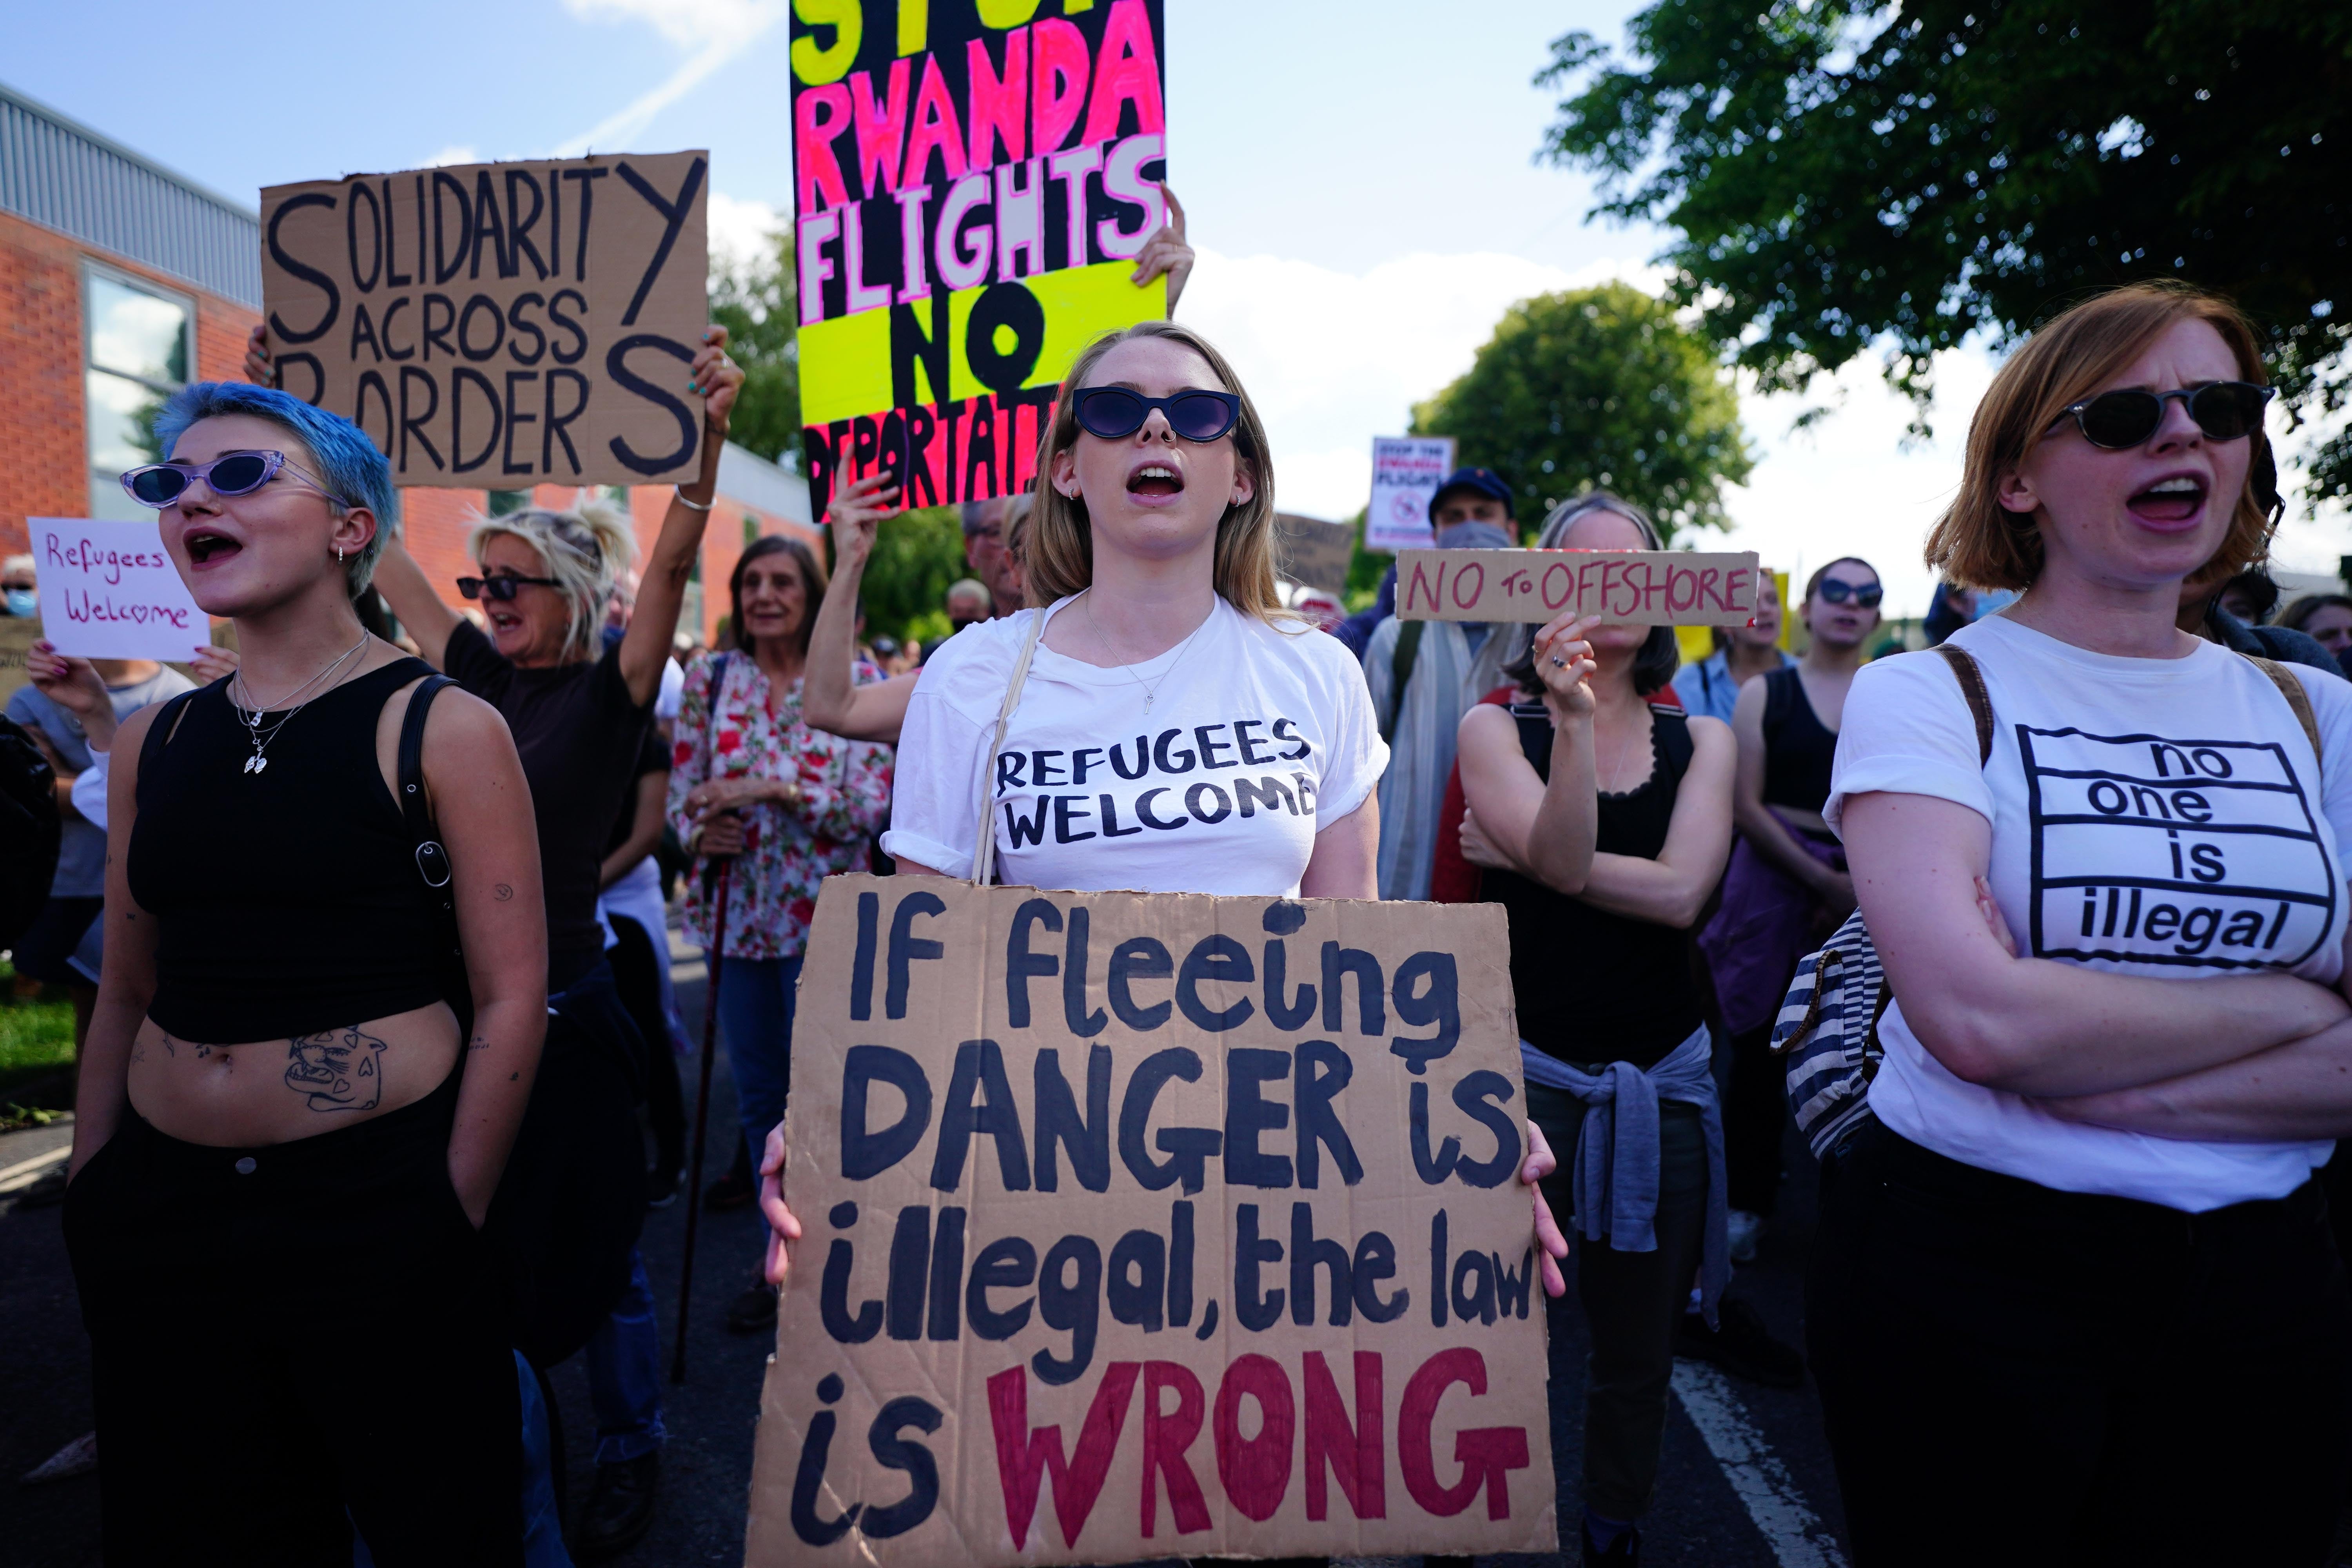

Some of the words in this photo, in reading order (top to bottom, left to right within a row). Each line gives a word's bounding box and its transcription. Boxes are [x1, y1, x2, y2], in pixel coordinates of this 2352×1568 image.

[796, 1, 1165, 214] RWANDA
[268, 156, 707, 344] SOLIDARITY
[798, 134, 1166, 327] FLIGHTS
[350, 289, 588, 365] ACROSS
[890, 281, 1045, 410] NO
[46, 532, 165, 585] Refugees
[1406, 560, 1485, 613] NO
[1541, 559, 1749, 619] OFFSHORE
[997, 718, 1312, 798] REFUGEES
[2150, 743, 2233, 779] no
[1005, 772, 1315, 849] WELCOME
[2087, 780, 2214, 824] one
[2167, 828, 2226, 883] is
[2080, 886, 2290, 955] illegal
[1006, 899, 1460, 1061] fleeing
[840, 1038, 1364, 1196] DANGER
[1405, 1056, 1521, 1189] is
[1234, 1201, 1410, 1331] the
[1430, 1208, 1533, 1328] law
[790, 1373, 944, 1548] is
[986, 1347, 1530, 1553] WRONG
